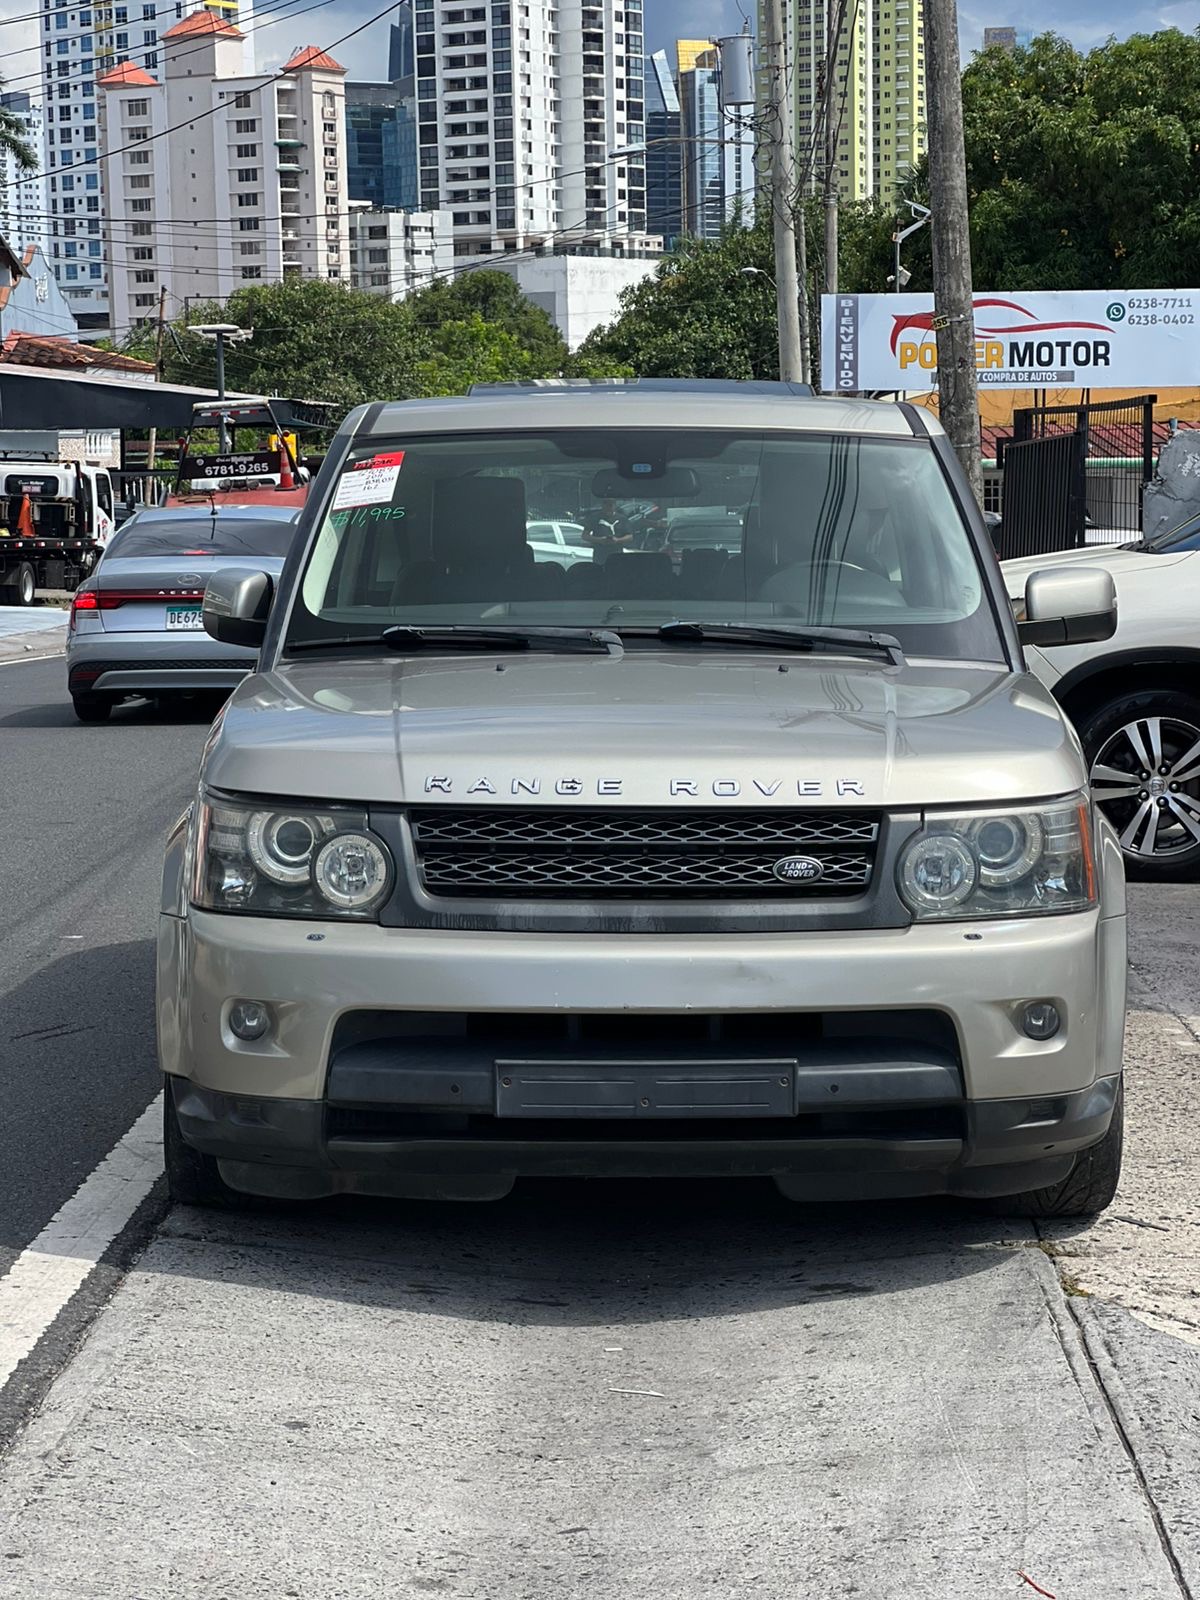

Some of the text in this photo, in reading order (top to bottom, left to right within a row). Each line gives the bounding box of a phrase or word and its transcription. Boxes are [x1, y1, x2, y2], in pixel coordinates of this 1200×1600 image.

[1128, 298, 1192, 309] 6238-7711
[1128, 314, 1195, 326] 6238-0402
[839, 299, 854, 387] BIENVENIDO
[899, 340, 1111, 369] POER MOTOR
[982, 372, 1016, 382] COMPRA
[1017, 372, 1029, 381] DE
[1030, 371, 1058, 381] AUTOS
[205, 463, 269, 476] 6781-9265
[331, 507, 405, 527] $11,995
[424, 776, 865, 797] RANGE ROVER
